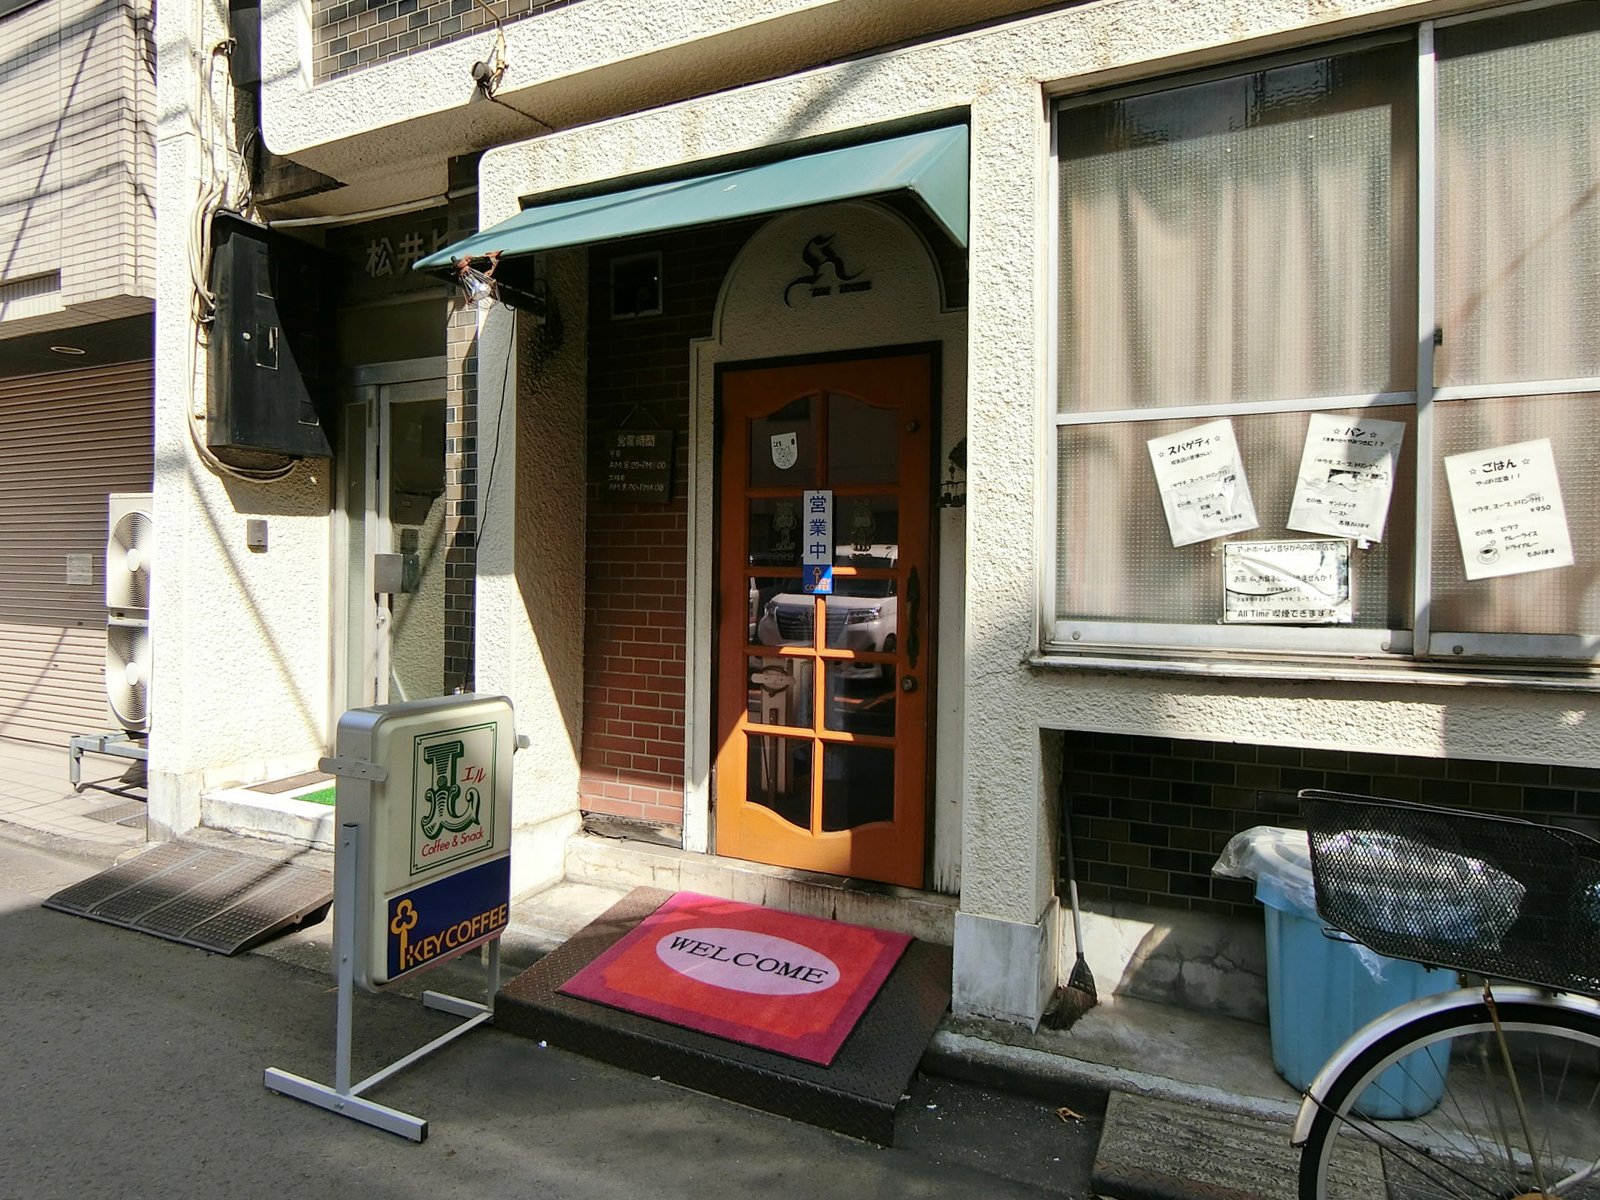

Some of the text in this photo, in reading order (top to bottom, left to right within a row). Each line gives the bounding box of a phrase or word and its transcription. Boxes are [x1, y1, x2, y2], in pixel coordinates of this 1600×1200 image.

[1345, 427, 1365, 437] パン
[1168, 437, 1210, 456] スパゲティ
[1482, 459, 1517, 473] ごはん
[809, 495, 826, 560] 営業中
[460, 765, 486, 784] エル
[421, 827, 484, 857] Coffee & Snack
[670, 935, 829, 985] WELCOME
